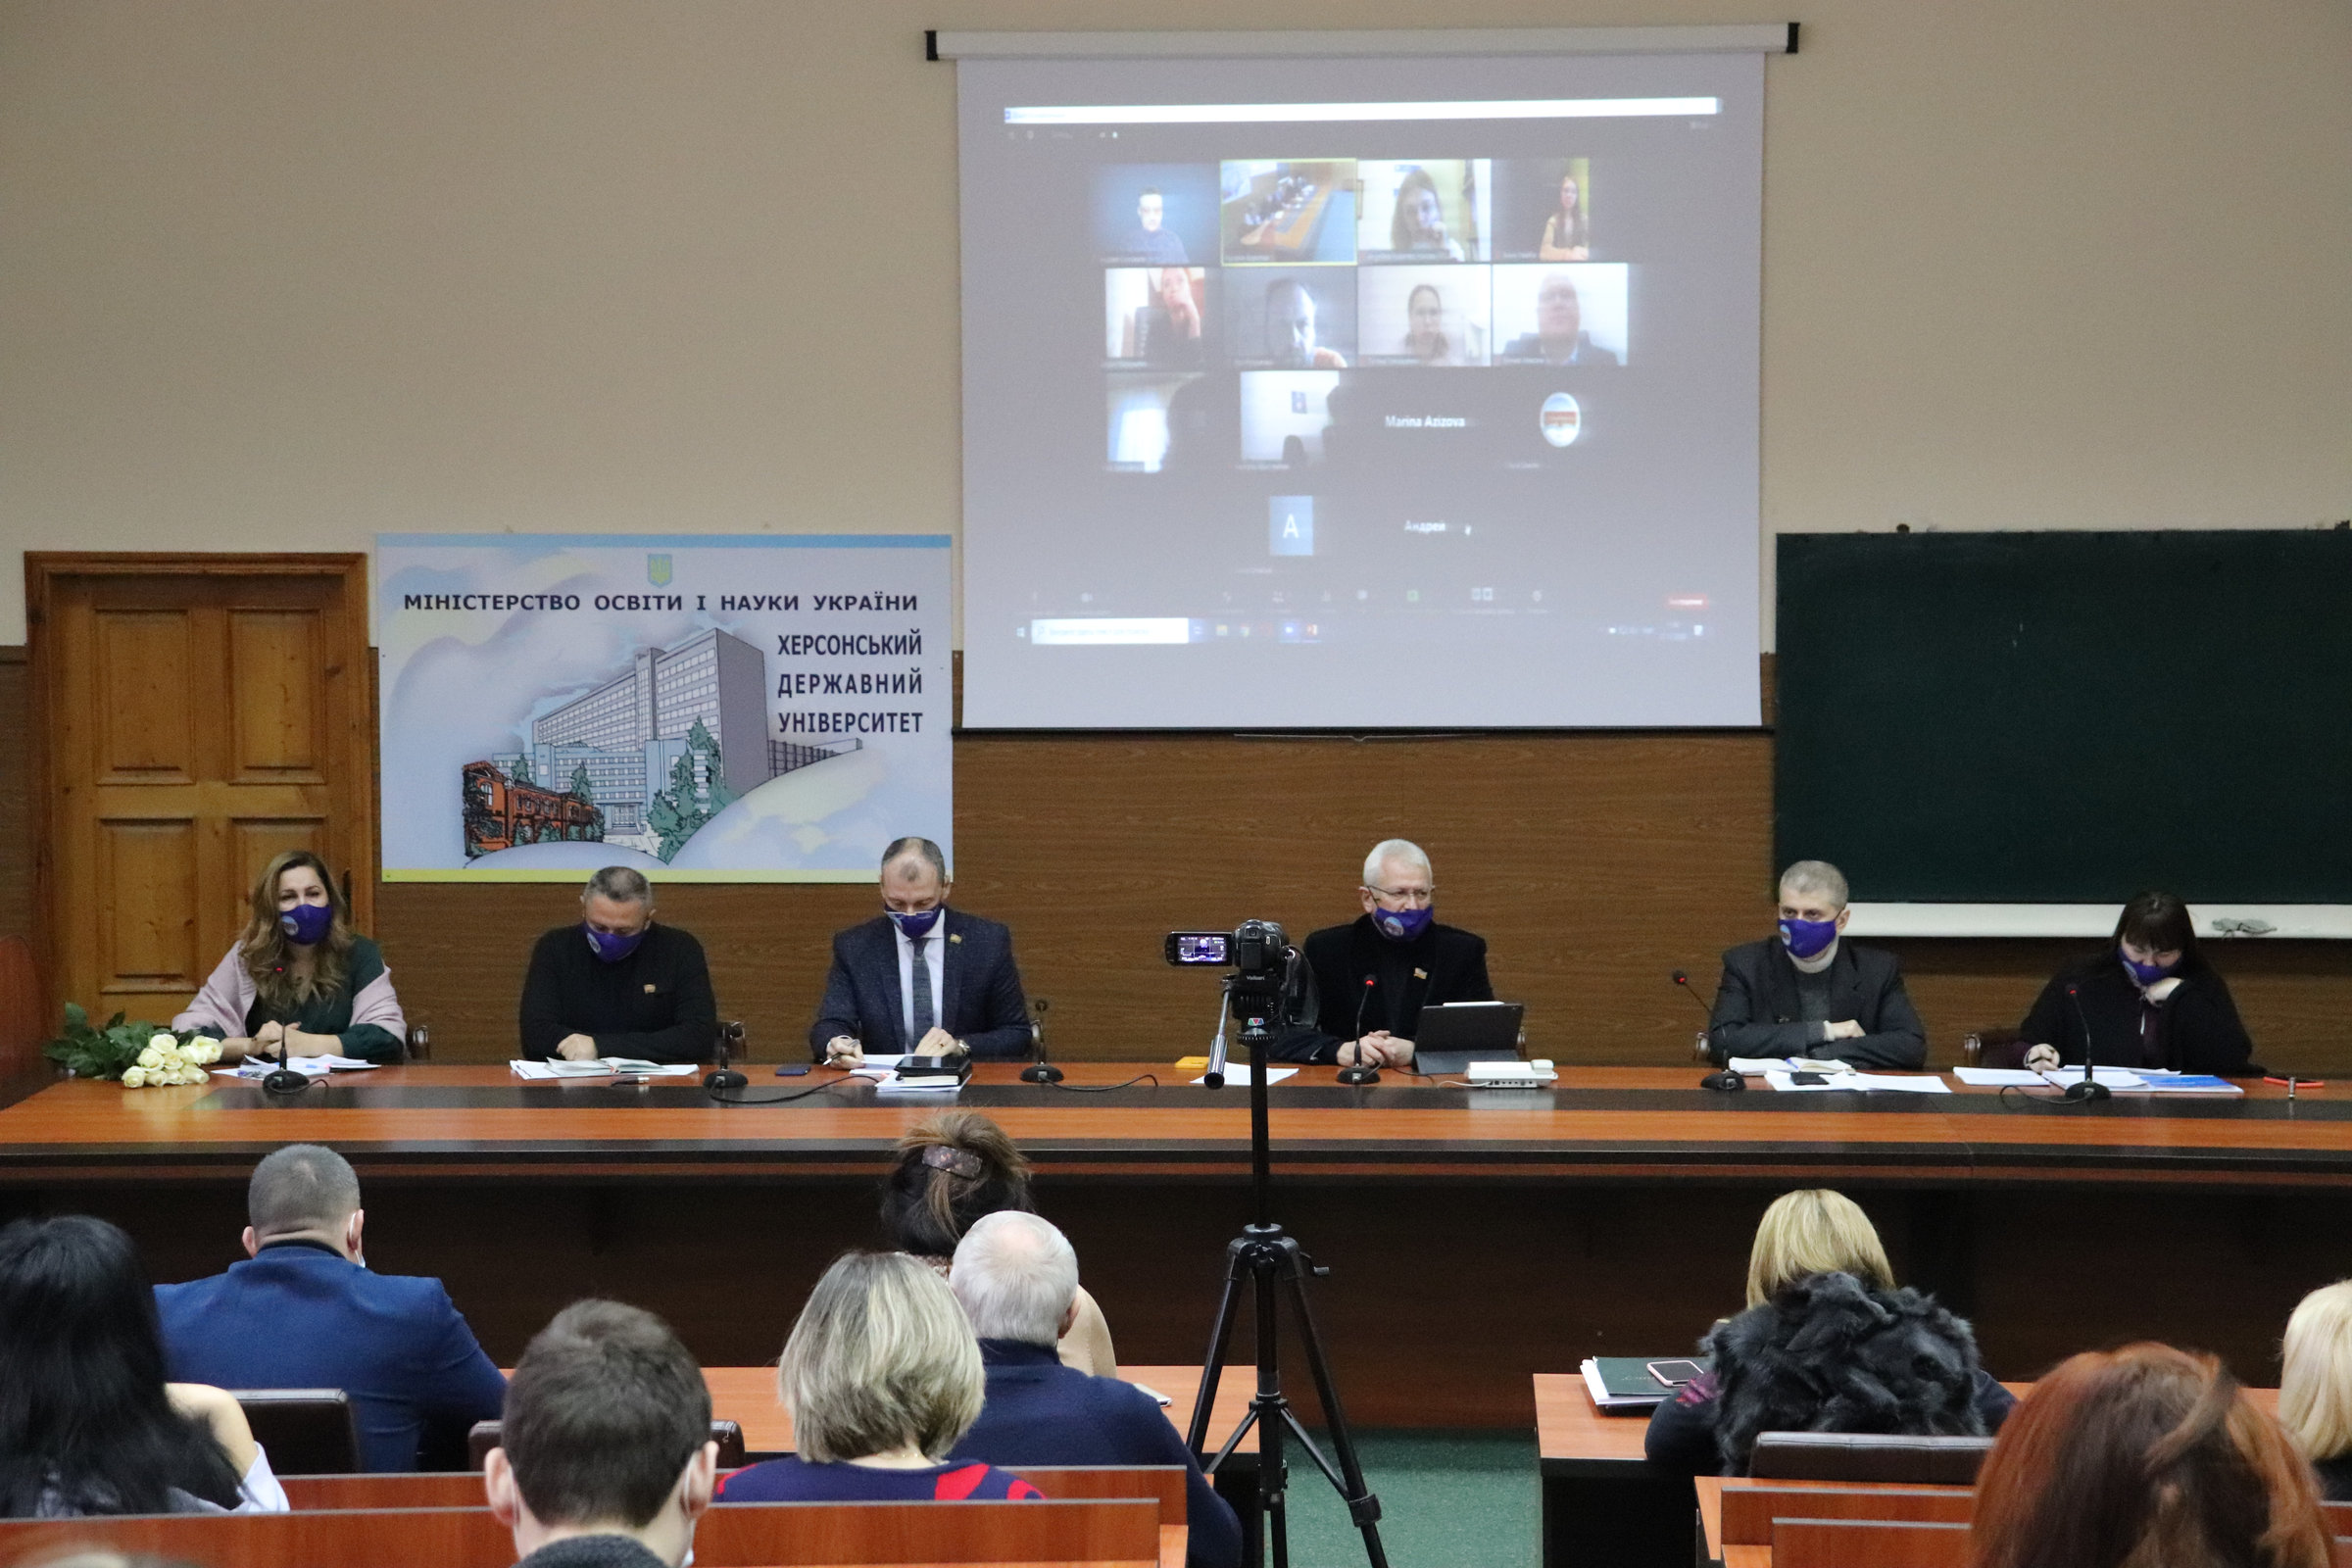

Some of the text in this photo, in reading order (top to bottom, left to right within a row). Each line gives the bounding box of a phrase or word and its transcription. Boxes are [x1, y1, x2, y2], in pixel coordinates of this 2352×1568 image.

[404, 591, 917, 612] МІНІСТЕРСТВО ОСВІТИ І НАУКИ УКРАЇНИ
[777, 629, 922, 657] ХЕРСОНСЬКИЙ
[777, 668, 922, 699] ДЕРЖАВНИЙ
[778, 711, 923, 733] УНІВЕРСИТЕТ
